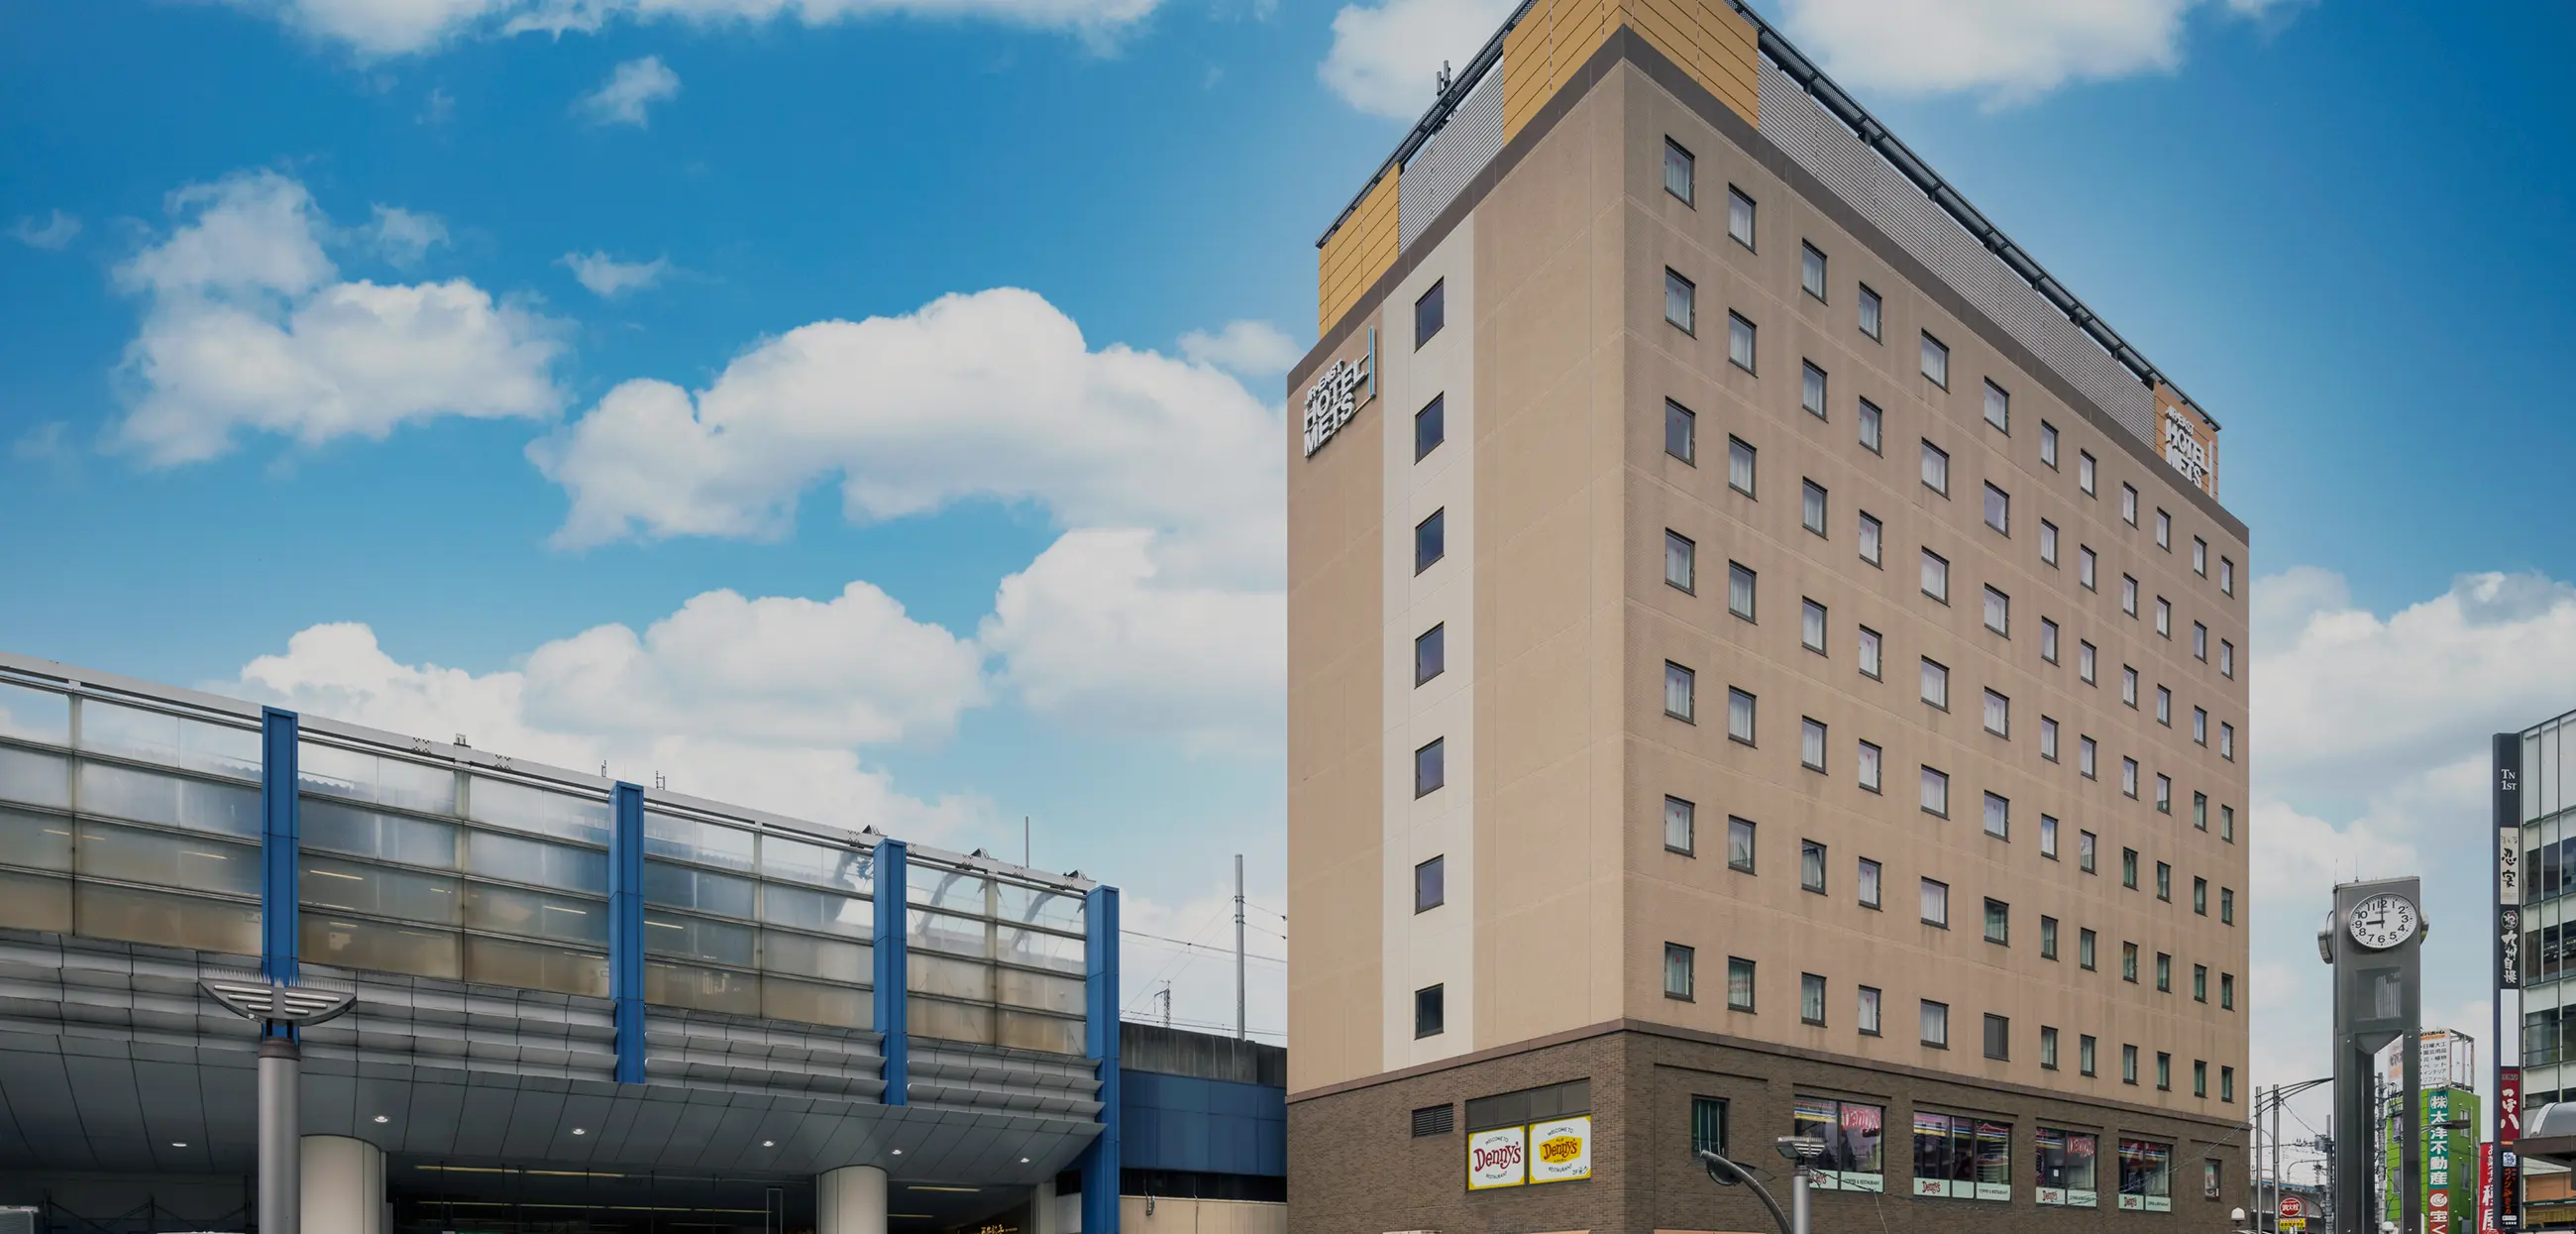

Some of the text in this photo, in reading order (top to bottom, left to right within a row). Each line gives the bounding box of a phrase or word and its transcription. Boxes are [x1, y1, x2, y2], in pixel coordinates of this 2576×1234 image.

[1304, 359, 1365, 433] HOTEL
[1304, 393, 1355, 457] METS
[2166, 419, 2209, 474] HOTEL
[2166, 442, 2201, 489] METS
[2377, 900, 2387, 908] 12
[2398, 906, 2405, 914] 2
[2358, 911, 2368, 919] 10
[2401, 915, 2409, 923] 3
[2359, 928, 2366, 936] 8
[2378, 935, 2385, 943] 6
[2501, 1089, 2519, 1129] つぼ八
[1547, 1127, 1567, 1136] WELCOME
[1485, 1136, 1503, 1145] WELCOME
[1543, 1138, 1577, 1160] Denny's
[1473, 1141, 1521, 1172] Denny's
[1548, 1163, 1573, 1172] RESTAURANT
[1486, 1170, 1507, 1179] RESTAURANT
[1922, 1181, 1940, 1194] Denny's
